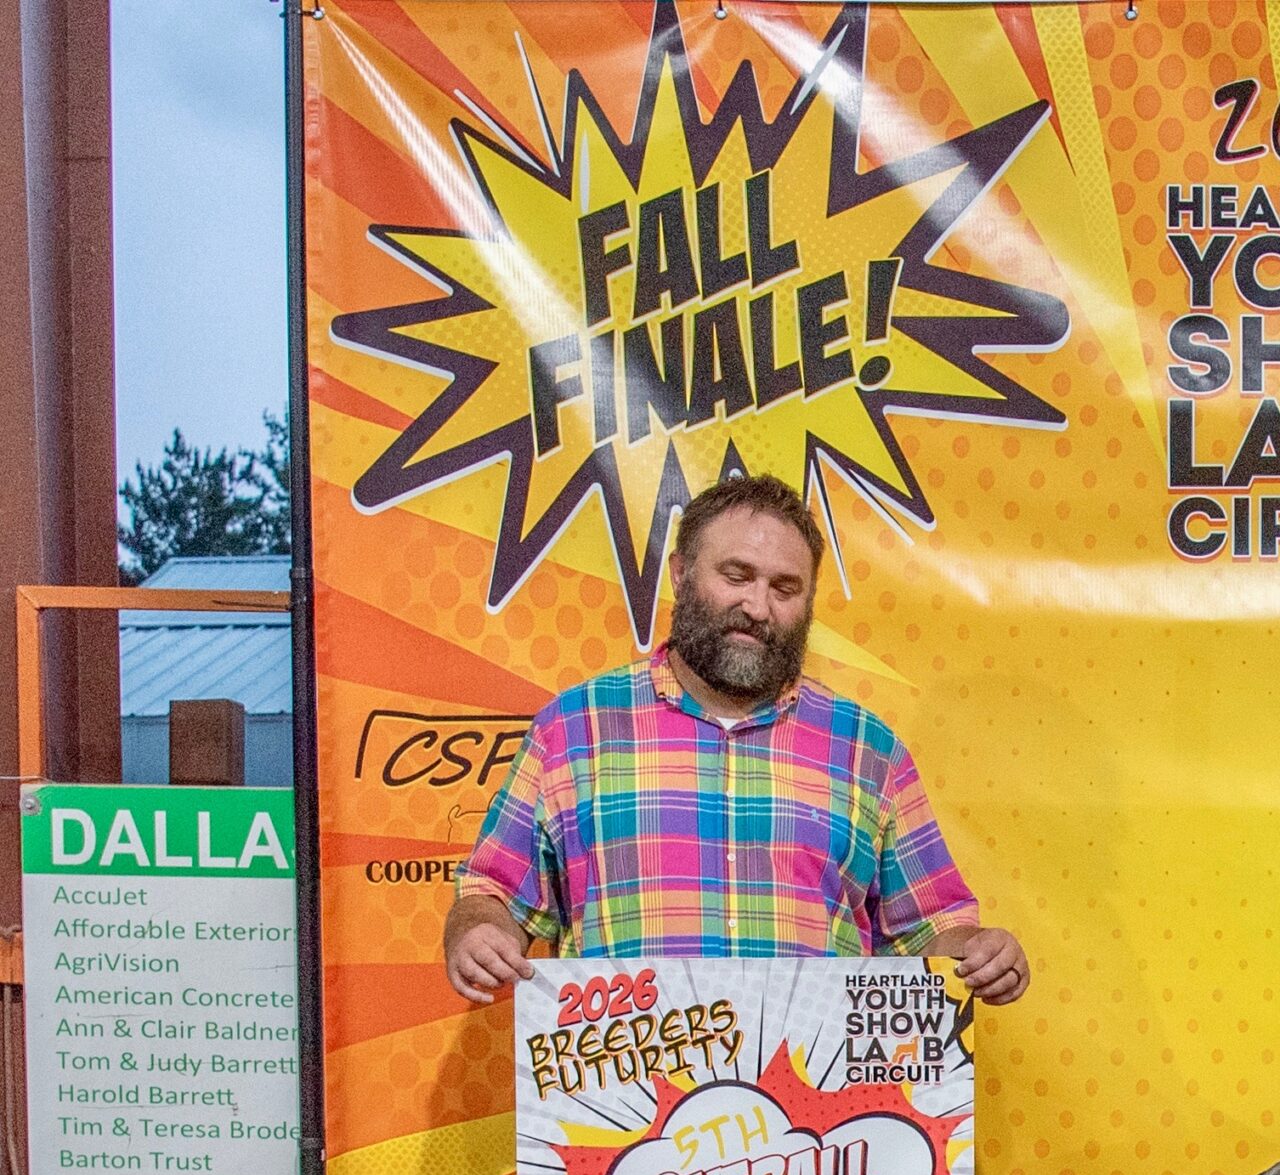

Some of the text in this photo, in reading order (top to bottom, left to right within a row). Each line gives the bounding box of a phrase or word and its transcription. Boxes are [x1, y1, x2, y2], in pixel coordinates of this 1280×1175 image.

[577, 168, 803, 330] FALL
[529, 258, 905, 462] FINALE!
[51, 808, 294, 869] DALLA
[53, 886, 148, 906] AccuJet
[54, 919, 186, 940] Affordable
[55, 953, 180, 976] AgriVision
[846, 975, 945, 987] HEARTLAND
[55, 986, 295, 1009] American Concrete
[557, 968, 659, 1028] 2026
[846, 989, 945, 1010] YOUTH
[56, 1020, 104, 1038] Ann
[113, 1020, 133, 1039] &
[141, 1020, 196, 1040] Clair
[526, 999, 739, 1070] BREEDERS
[846, 1012, 944, 1035] SHOW
[57, 1052, 298, 1076] Tom & Judy Barrett
[532, 1030, 744, 1101] FUTURITY
[846, 1065, 945, 1084] CIRCUIT
[58, 1085, 235, 1107] Harold Barrett
[58, 1117, 103, 1136] Tim
[112, 1118, 131, 1137] &
[139, 1119, 221, 1140] Teresa
[672, 1105, 770, 1170] 5TH
[60, 1151, 213, 1172] Barton Trust
